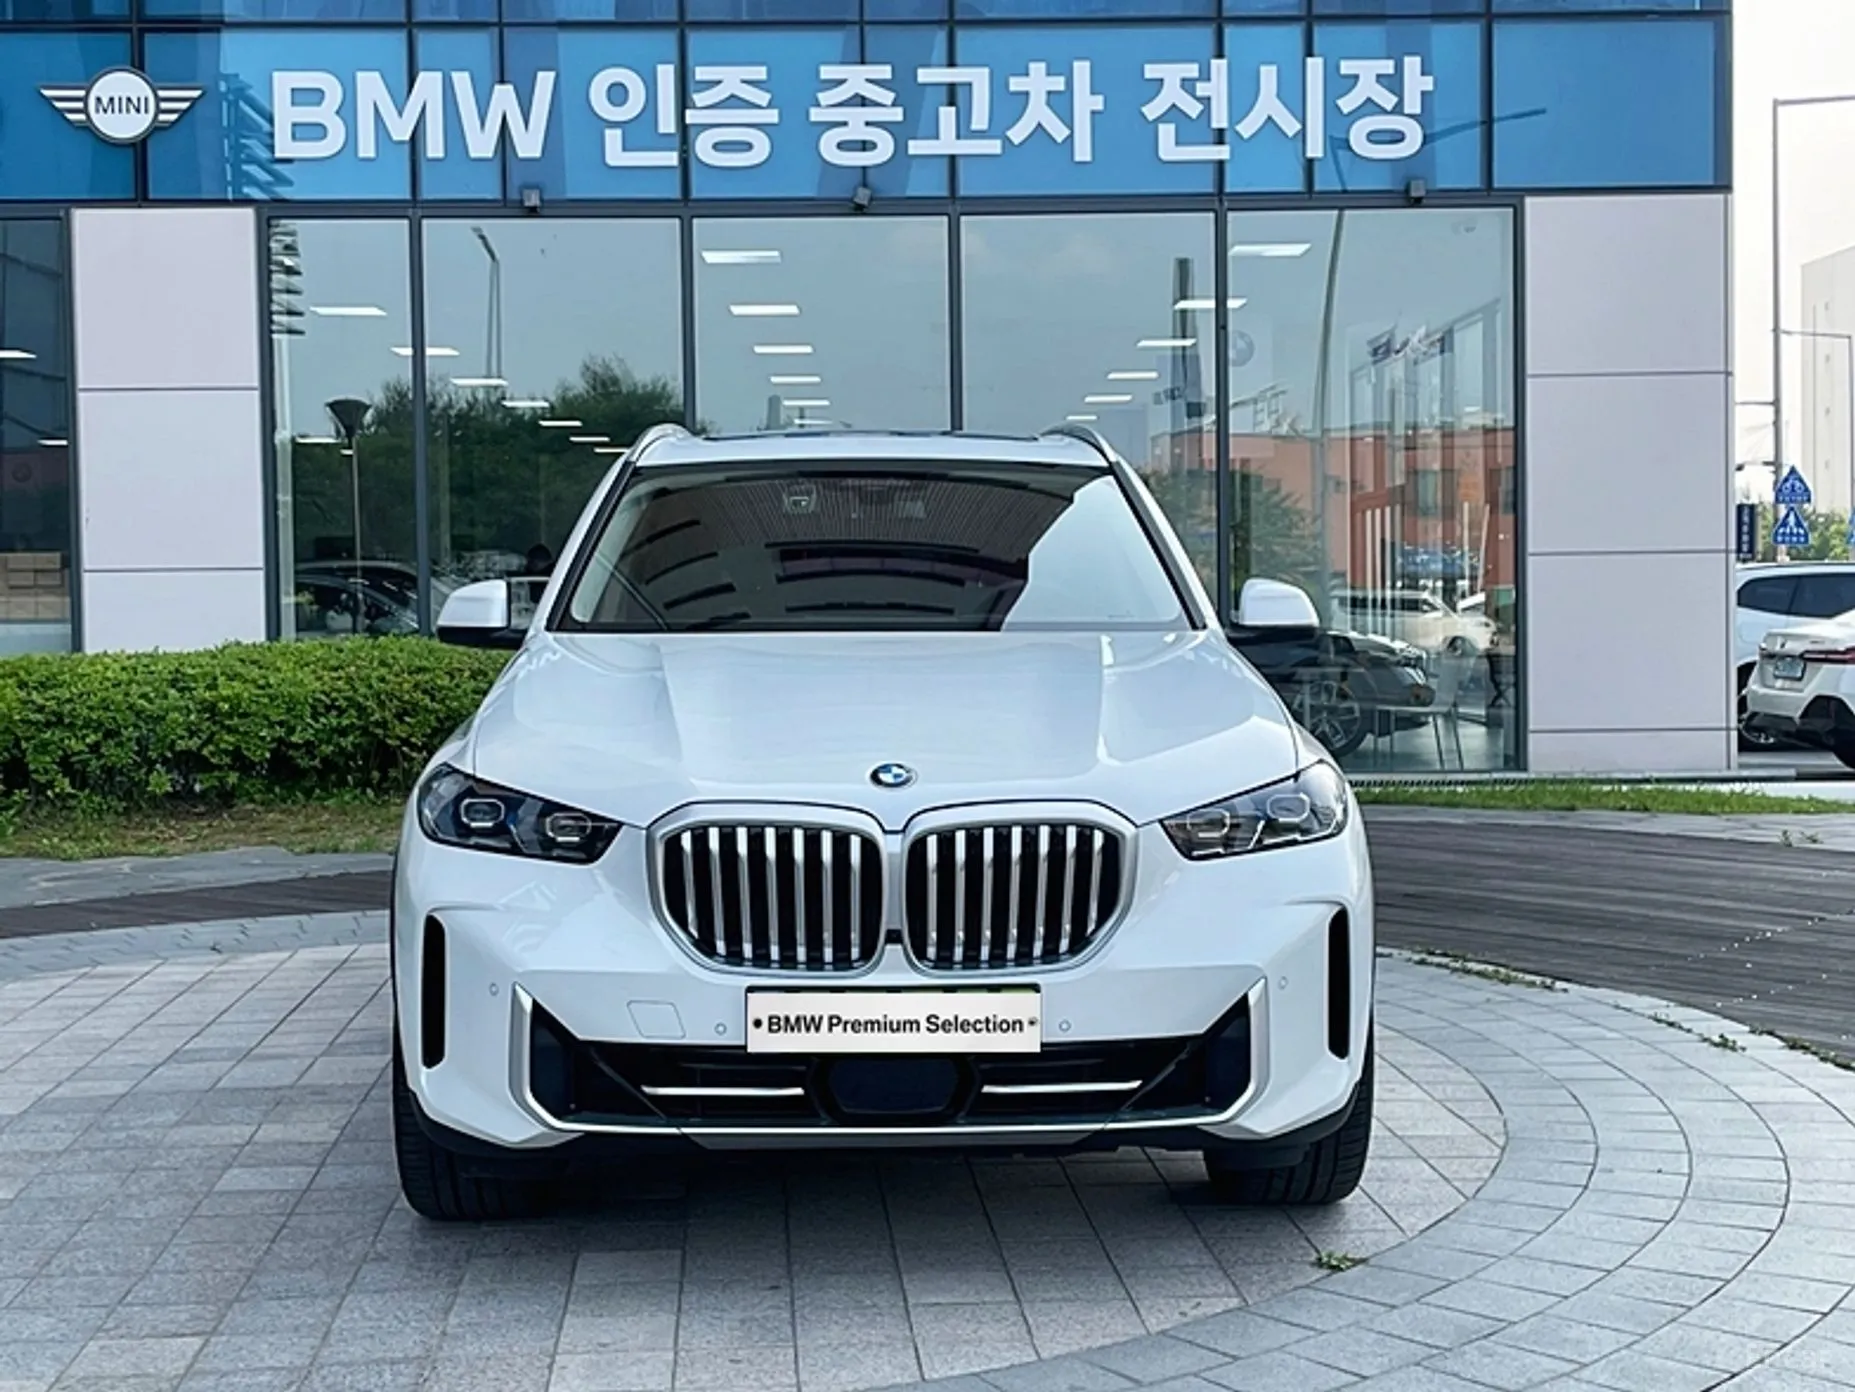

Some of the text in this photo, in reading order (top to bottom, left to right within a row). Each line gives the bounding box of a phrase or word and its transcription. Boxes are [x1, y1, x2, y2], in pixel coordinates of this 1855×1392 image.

[95, 96, 149, 115] MINI
[272, 55, 1434, 168] BMW 인증 중고차 전시장
[767, 1013, 1024, 1034] BMW Premium Selection
